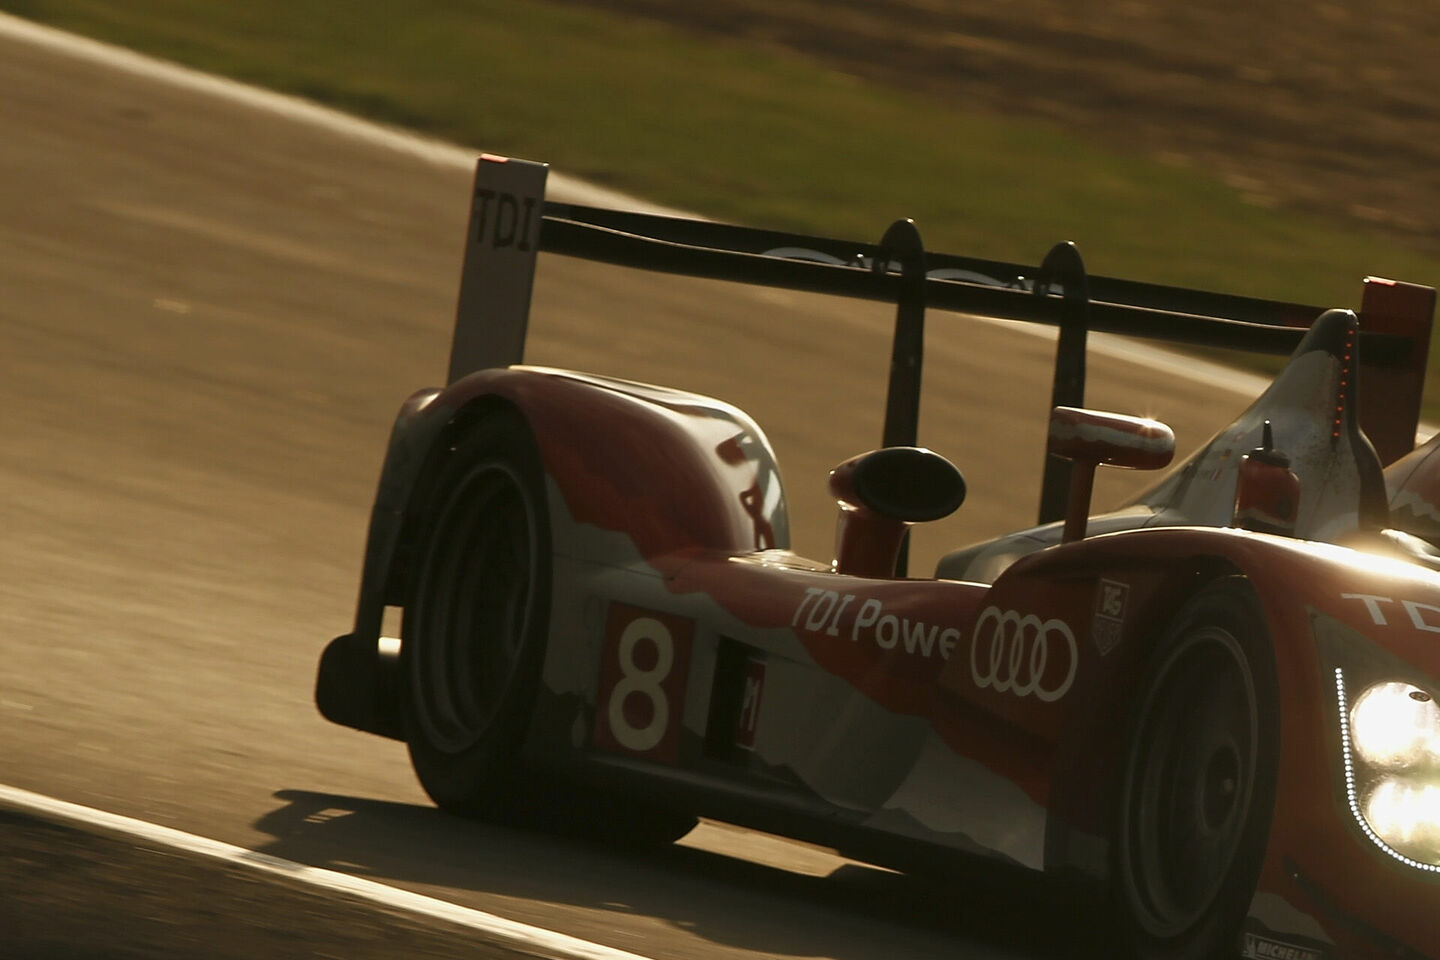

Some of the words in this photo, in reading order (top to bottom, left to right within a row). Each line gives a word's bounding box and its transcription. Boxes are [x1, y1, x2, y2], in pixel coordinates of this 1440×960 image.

[473, 188, 537, 252] TDI
[791, 587, 856, 637] TDI
[851, 598, 961, 661] Powe
[608, 617, 674, 751] 8
